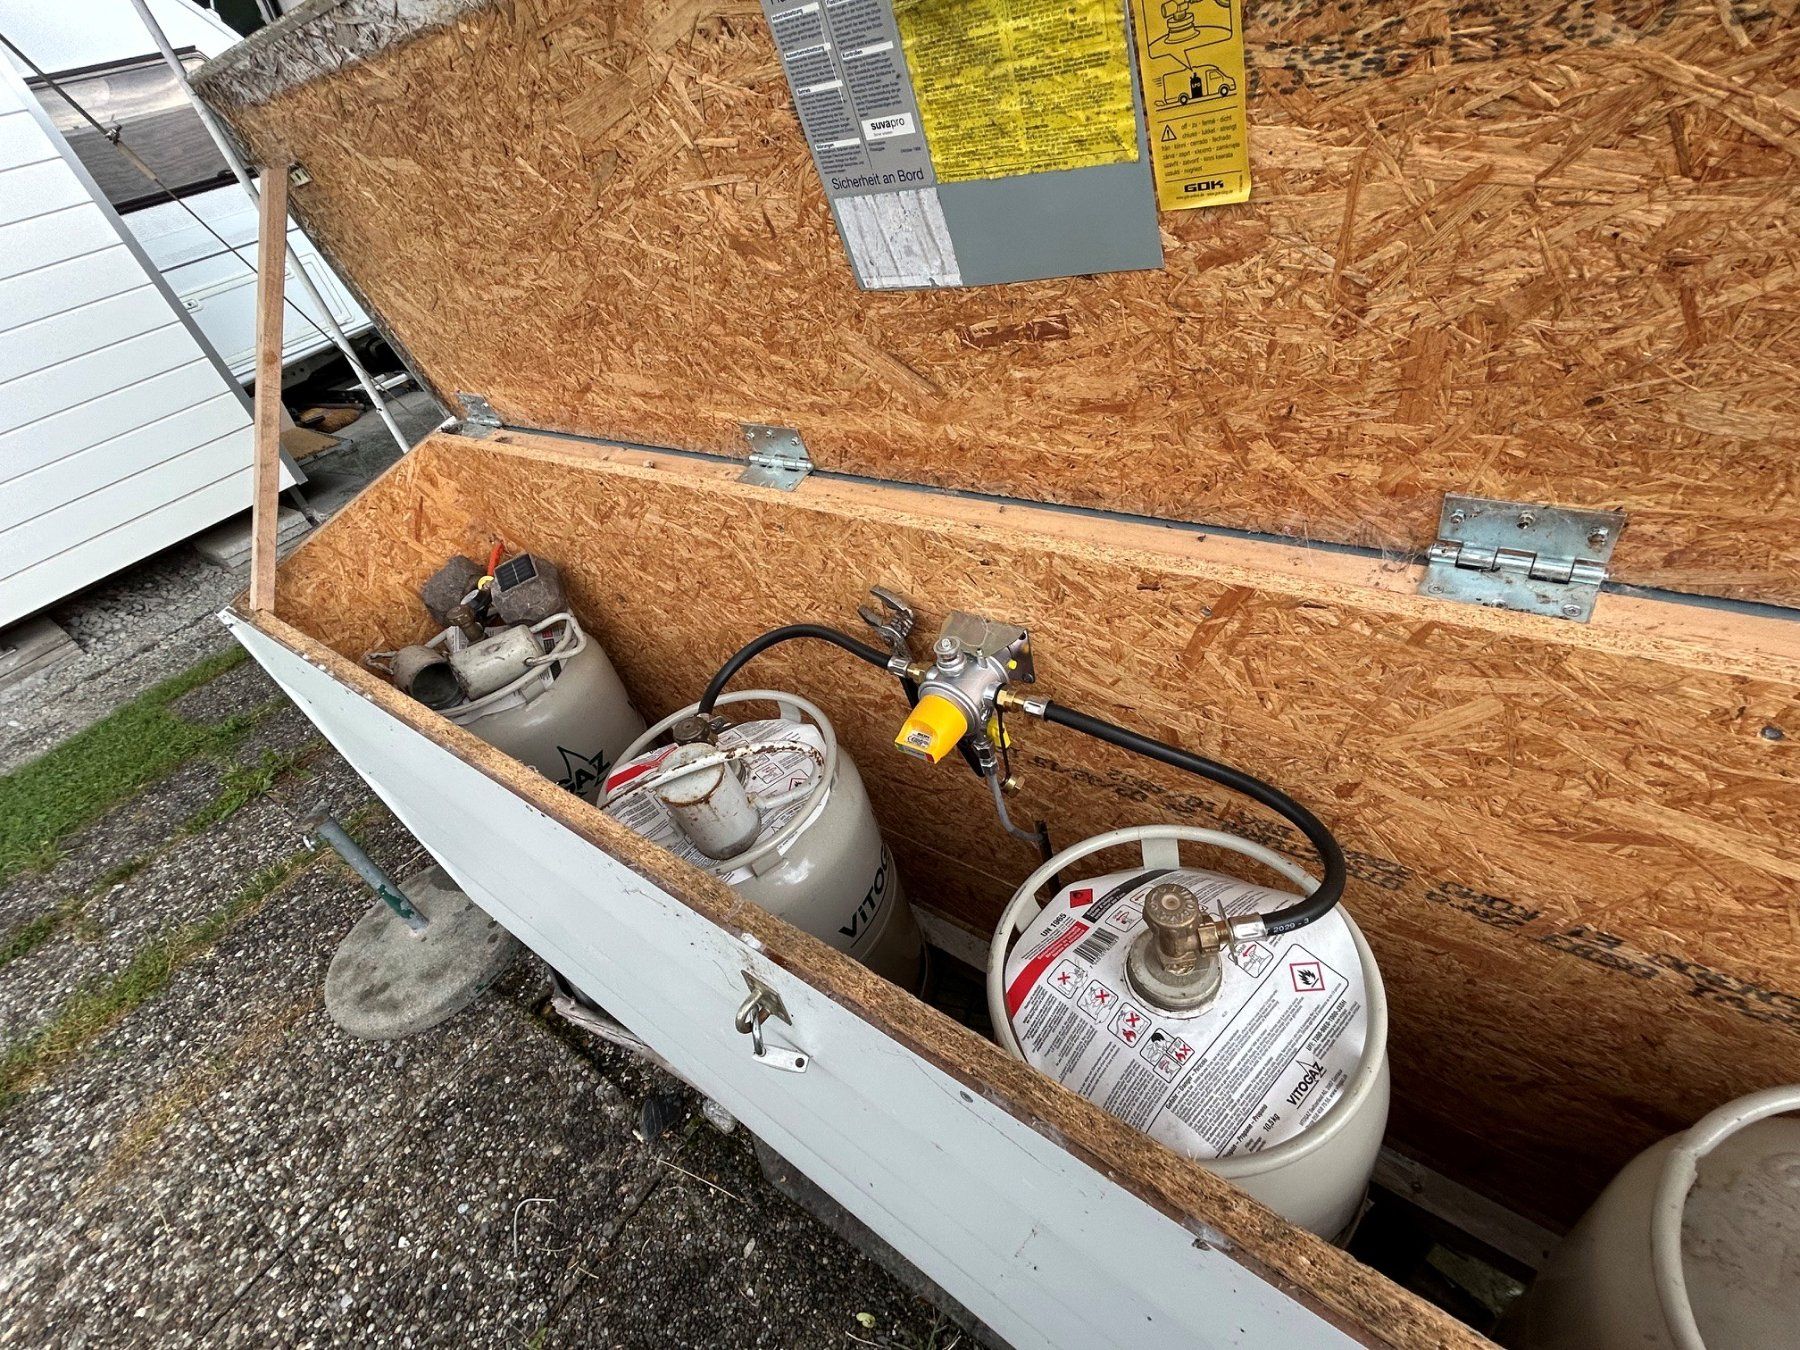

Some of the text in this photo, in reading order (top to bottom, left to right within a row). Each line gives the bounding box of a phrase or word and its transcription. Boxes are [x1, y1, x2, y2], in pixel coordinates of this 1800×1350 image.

[870, 117, 905, 131] suvapro
[831, 174, 880, 190] Sicherheit
[882, 175, 896, 184] an
[896, 168, 925, 182] Bord
[1184, 180, 1224, 192] GOK
[1040, 911, 1067, 938] UN 1965
[1164, 1057, 1208, 1109] Gefahr Danger Pericolo
[1286, 1061, 1324, 1106] VITOGAZ
